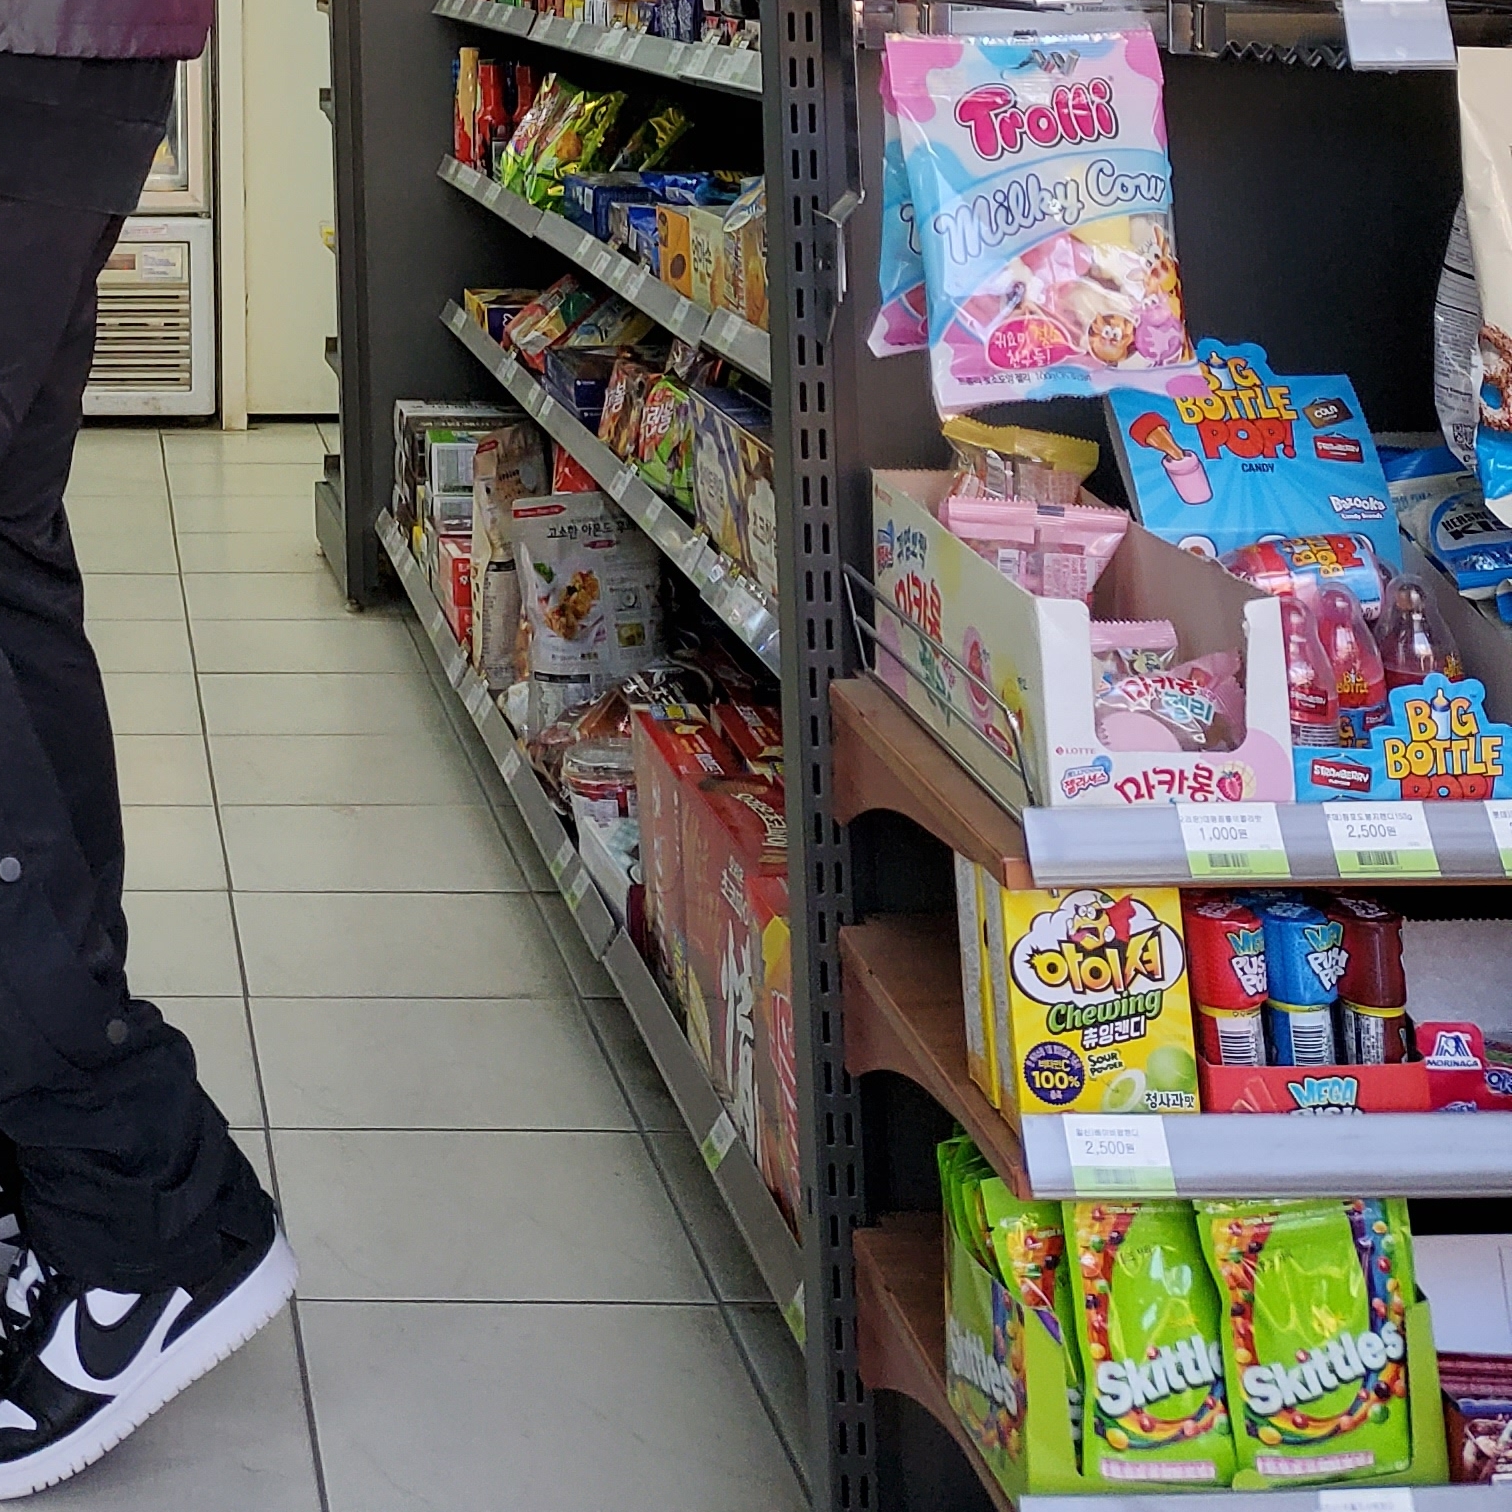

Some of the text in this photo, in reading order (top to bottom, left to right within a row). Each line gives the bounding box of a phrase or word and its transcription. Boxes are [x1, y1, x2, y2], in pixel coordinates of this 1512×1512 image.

[954, 76, 1120, 160] Trolli
[934, 159, 1164, 265] Milky Cow
[994, 331, 1025, 349] 귀요미
[1174, 385, 1299, 424] BOTTLE
[1196, 418, 1297, 460] POP!
[1241, 462, 1276, 473] CANDY
[1328, 494, 1387, 513] Bazooka
[1122, 676, 1200, 701] 마카롱
[1163, 690, 1216, 724] 젤리
[1065, 747, 1097, 755] LOTTE
[1383, 737, 1503, 780] BOTTLE
[1114, 763, 1216, 804] 마카롱
[1313, 762, 1370, 784] STRAWBERRY
[1199, 826, 1248, 841] 1,000원
[1346, 823, 1397, 839] 2,500원
[1026, 921, 1167, 996] 아이셔
[1046, 988, 1163, 1036] Chewing
[1082, 1020, 1146, 1048] 츄잉캔디
[1087, 1052, 1118, 1067] SOUR
[1089, 1060, 1124, 1076] POWDER
[1426, 1058, 1480, 1068] MORINAGA
[1031, 1070, 1080, 1089] 100%
[1287, 1076, 1358, 1108] MEGA
[1145, 1091, 1195, 1110] 청사과맛
[1085, 1140, 1135, 1155] 2,500원
[948, 1316, 1018, 1414] Skittles
[1243, 1321, 1406, 1414] Skittles
